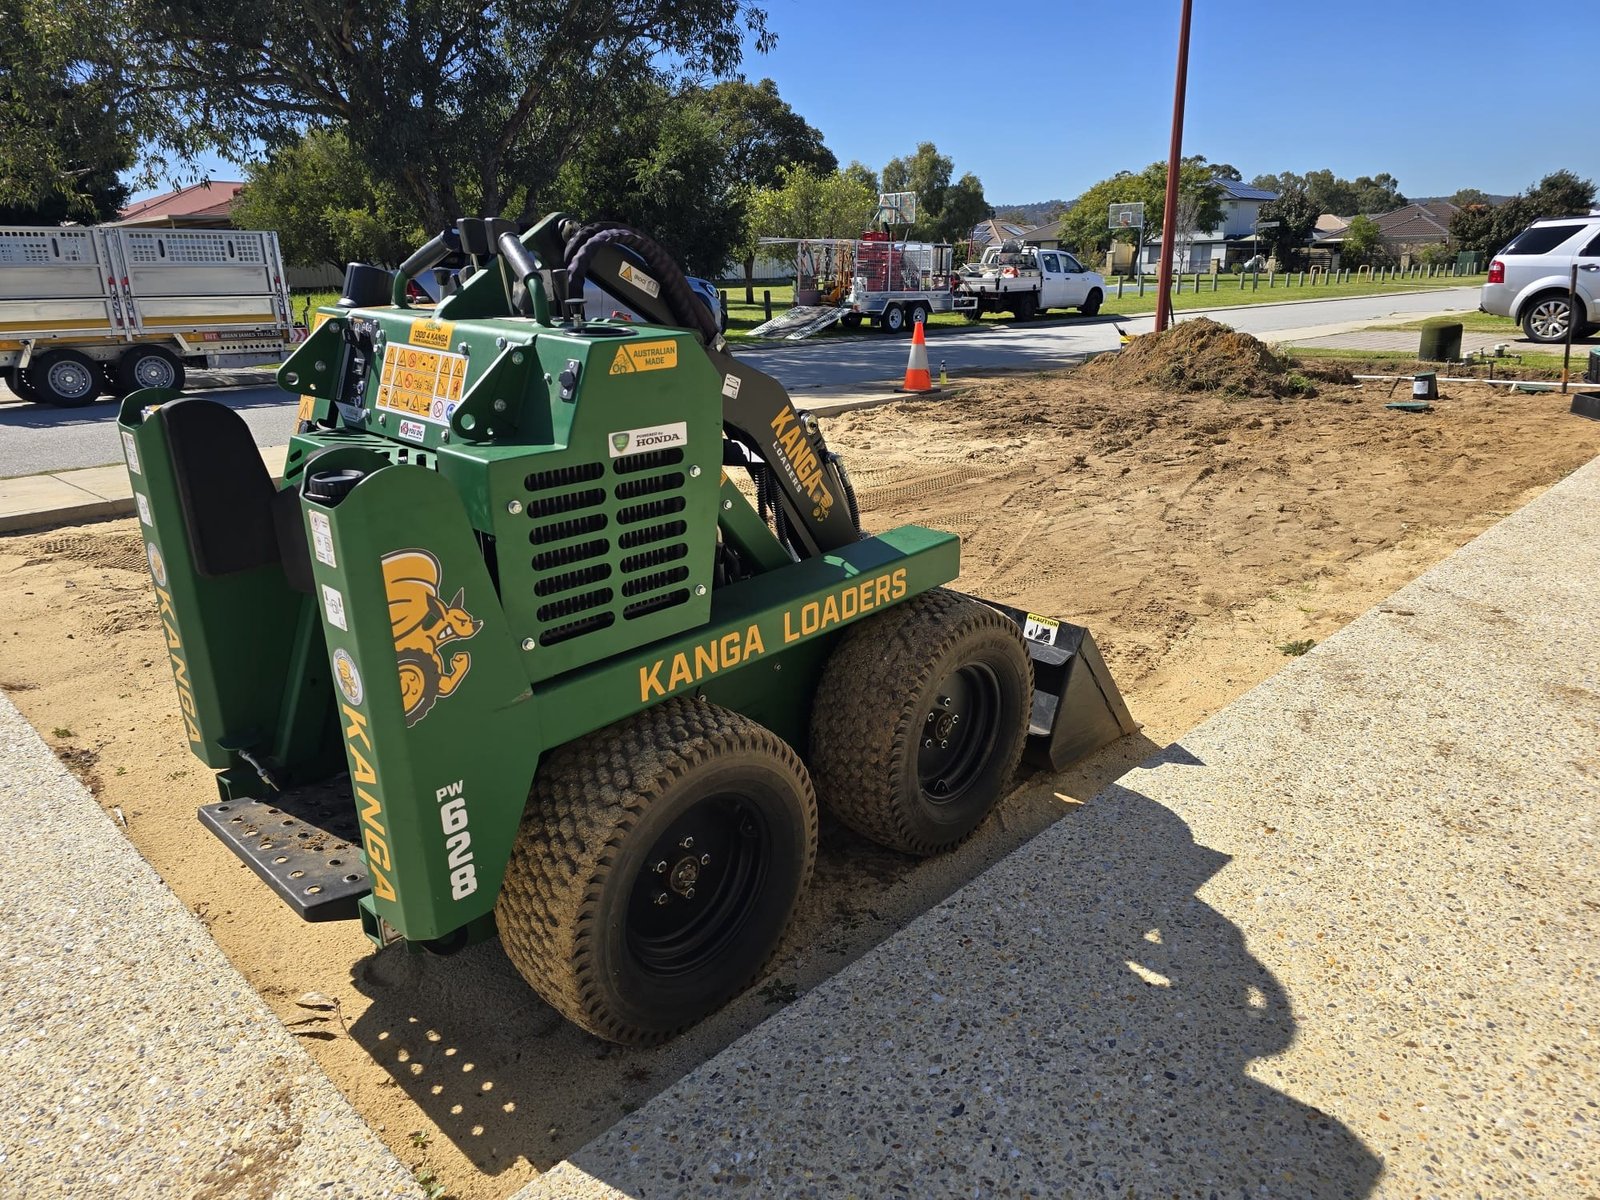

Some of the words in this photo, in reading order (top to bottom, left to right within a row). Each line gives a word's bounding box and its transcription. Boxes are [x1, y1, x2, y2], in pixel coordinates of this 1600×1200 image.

[430, 332, 448, 342] KANGA
[633, 346, 675, 358] AUSTRALIAN
[644, 356, 665, 366] MADE
[636, 433, 680, 447] HONDA
[770, 405, 823, 498] KANGA
[772, 441, 802, 493] LOADERS
[639, 624, 765, 702] KANGA
[784, 568, 907, 643] LOADERS
[1032, 616, 1058, 627] CAUTION
[155, 586, 201, 743] KANGA
[342, 703, 397, 903] KANGA
[436, 780, 464, 803] PW
[440, 797, 478, 901] 628
